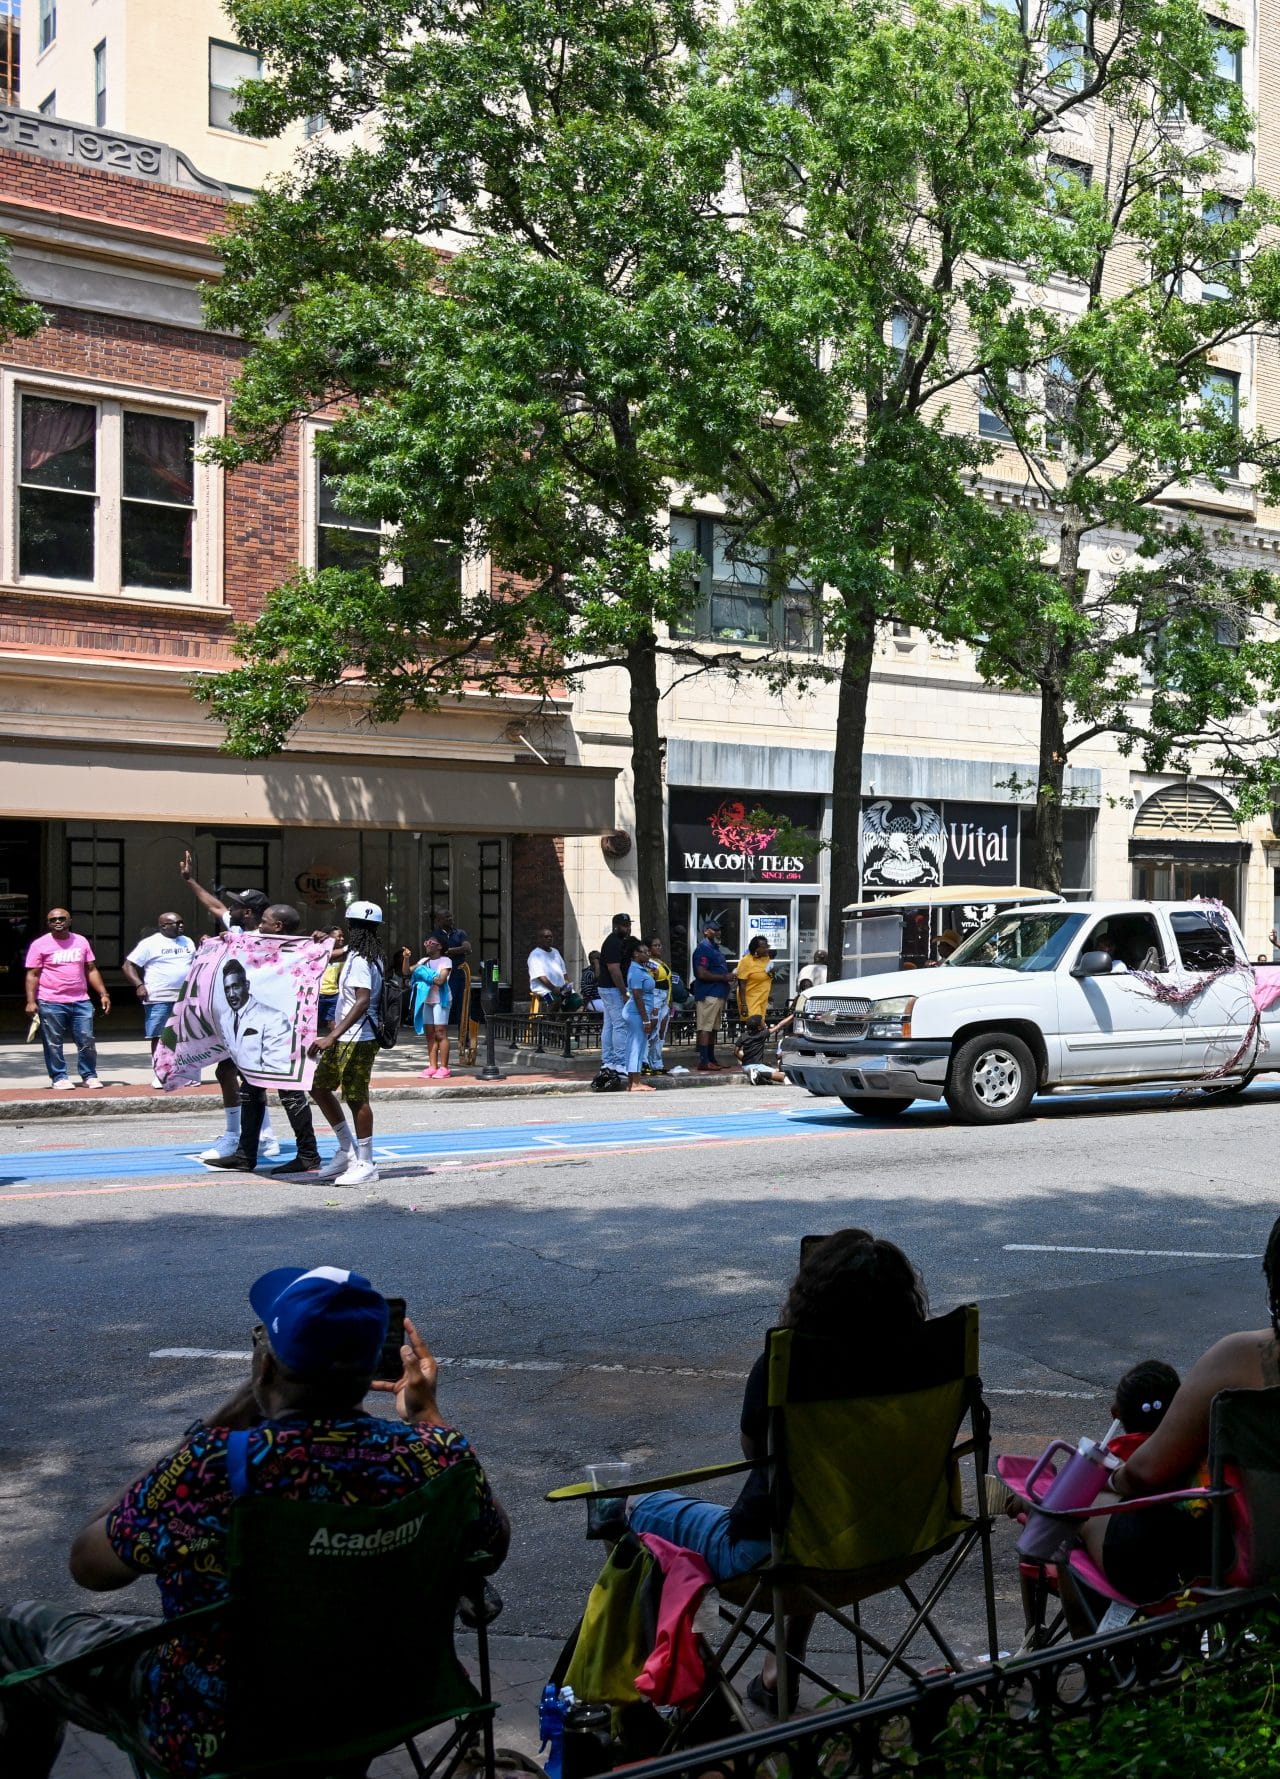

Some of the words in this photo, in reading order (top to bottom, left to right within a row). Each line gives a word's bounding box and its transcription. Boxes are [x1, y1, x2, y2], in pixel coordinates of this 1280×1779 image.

[67, 129, 160, 174] 1929
[684, 852, 756, 870] MACON
[759, 855, 804, 871] TEES
[950, 823, 1009, 867] Vital
[52, 949, 82, 964] NIKE
[310, 1512, 428, 1549] Academy
